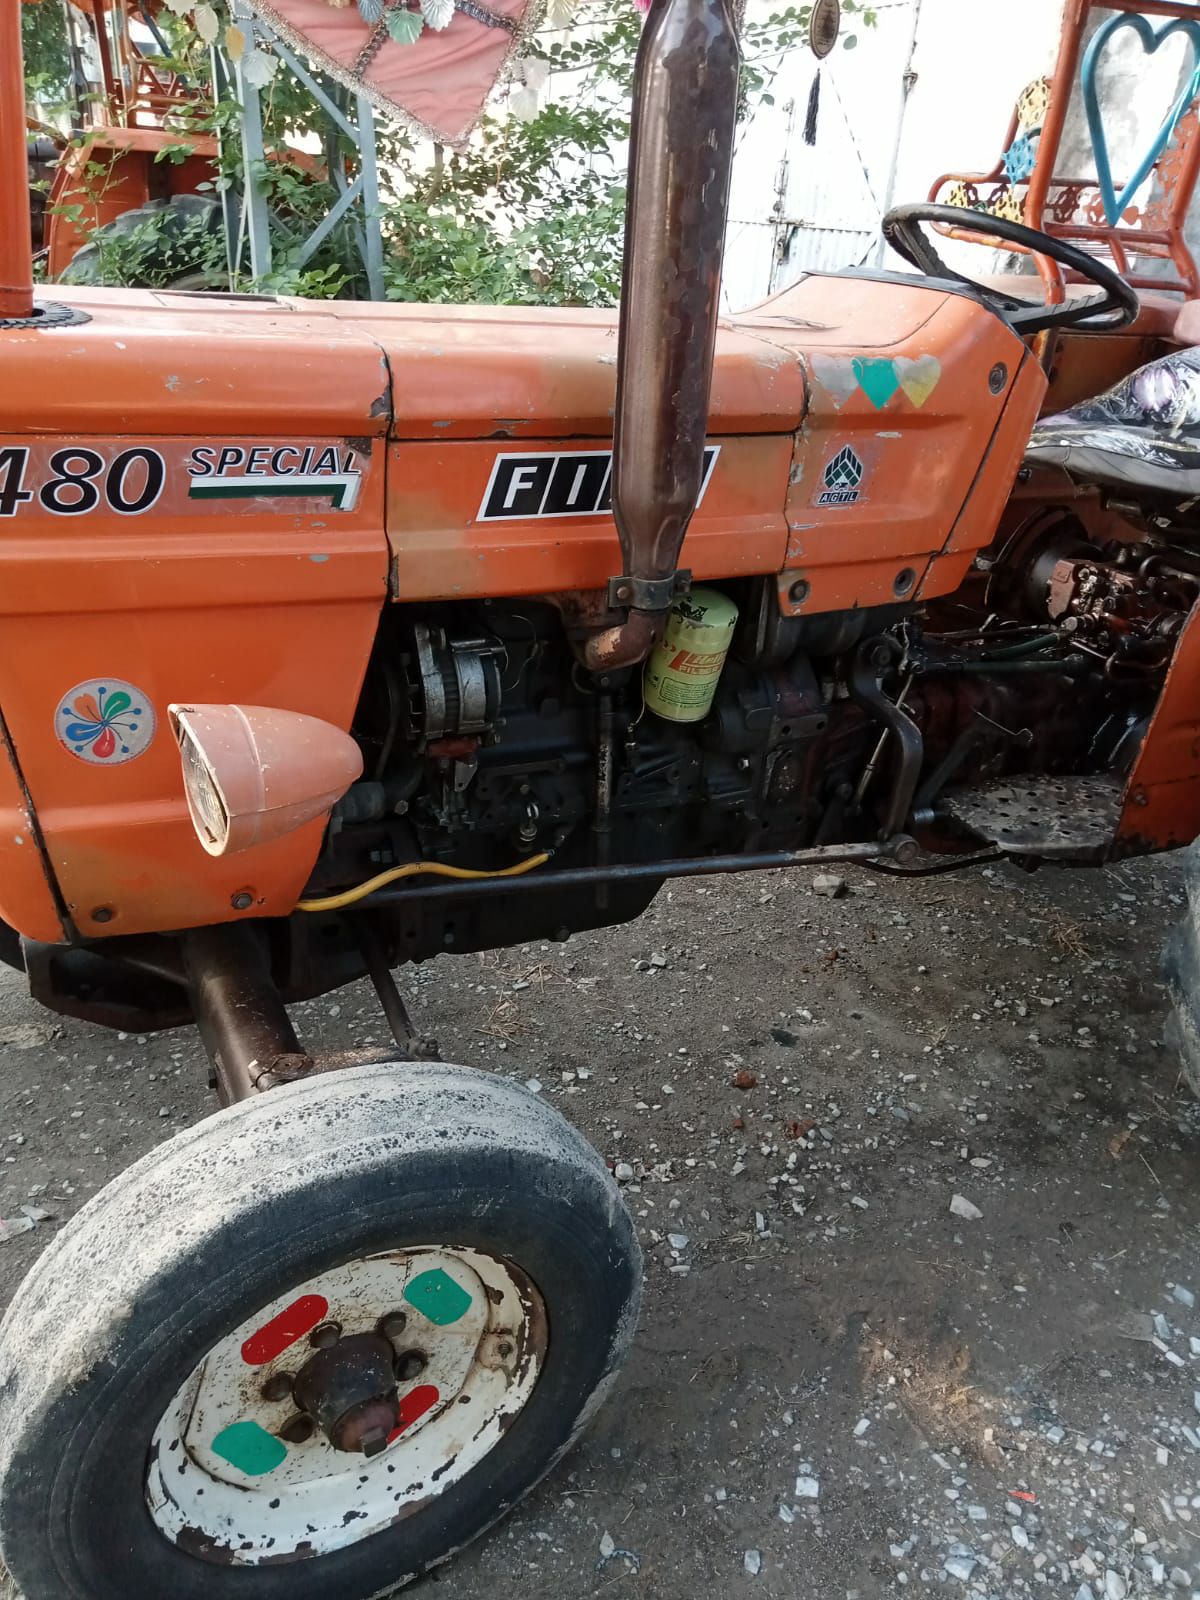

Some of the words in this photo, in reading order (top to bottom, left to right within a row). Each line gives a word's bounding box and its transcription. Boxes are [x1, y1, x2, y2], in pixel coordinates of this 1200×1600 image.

[0, 447, 166, 517] 480
[187, 446, 362, 476] SPECIAL
[820, 492, 856, 503] AGTL
